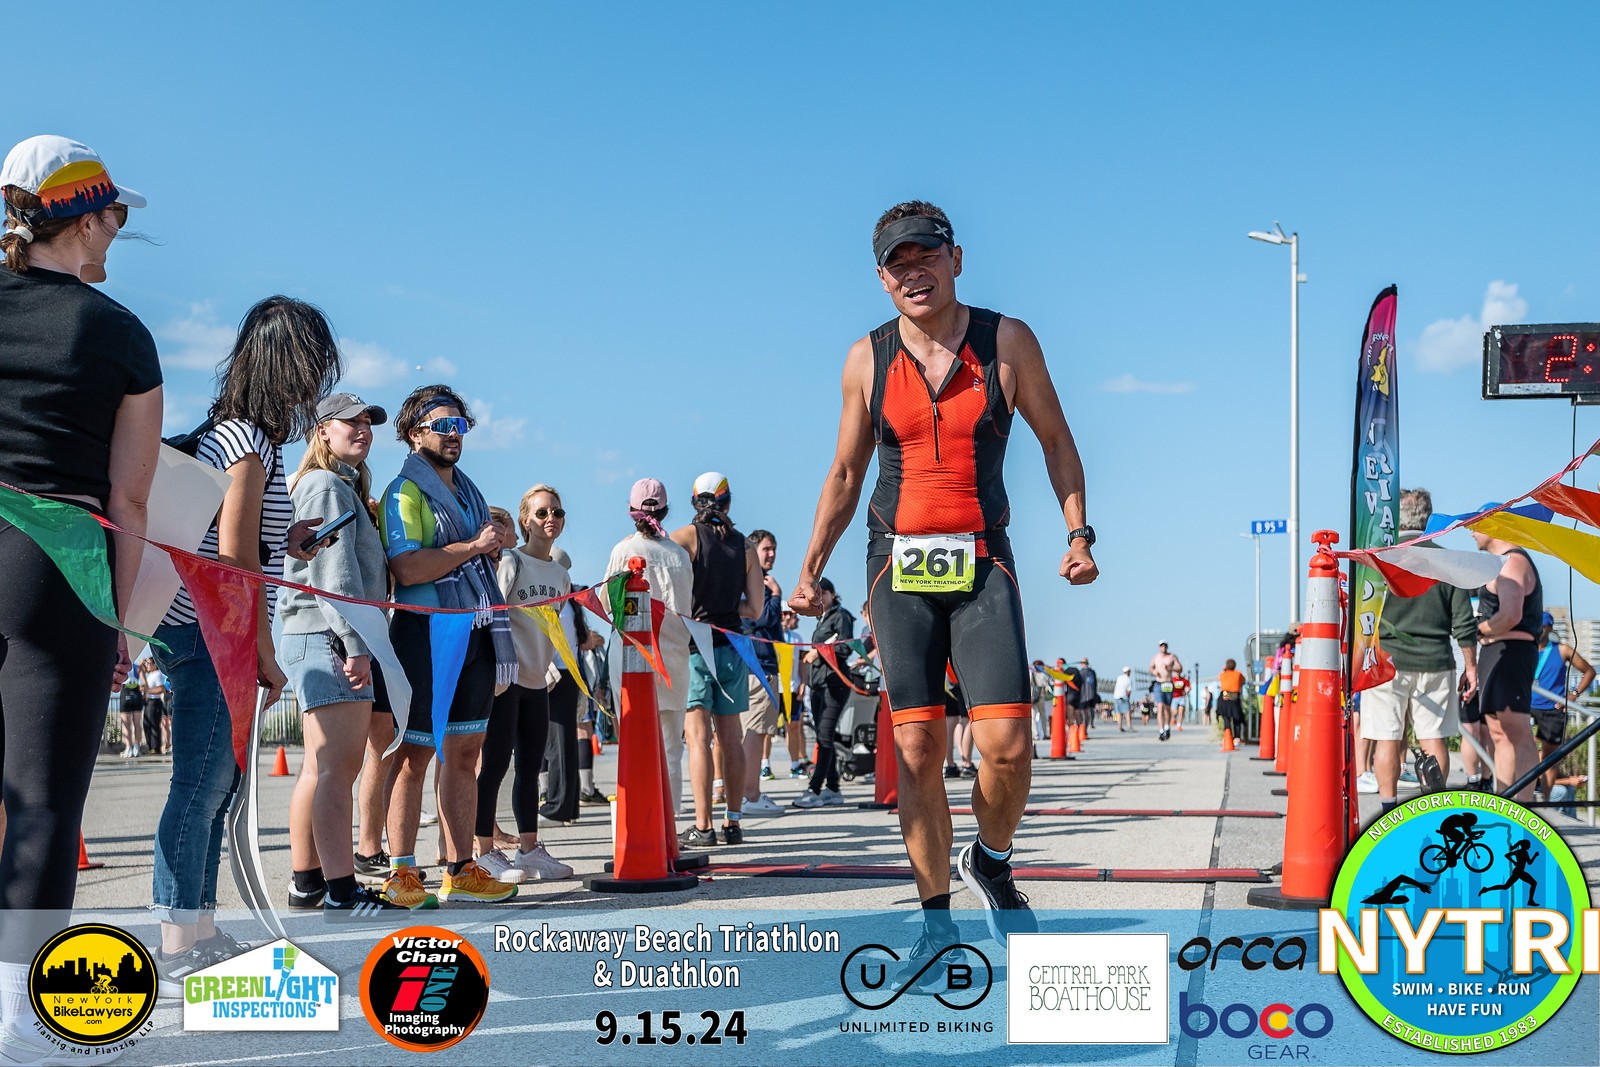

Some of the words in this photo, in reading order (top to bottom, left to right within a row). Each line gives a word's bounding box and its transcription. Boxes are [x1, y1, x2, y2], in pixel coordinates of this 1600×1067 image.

[1264, 521, 1276, 533] 95
[902, 547, 965, 577] 261
[446, 722, 481, 731] ynergy
